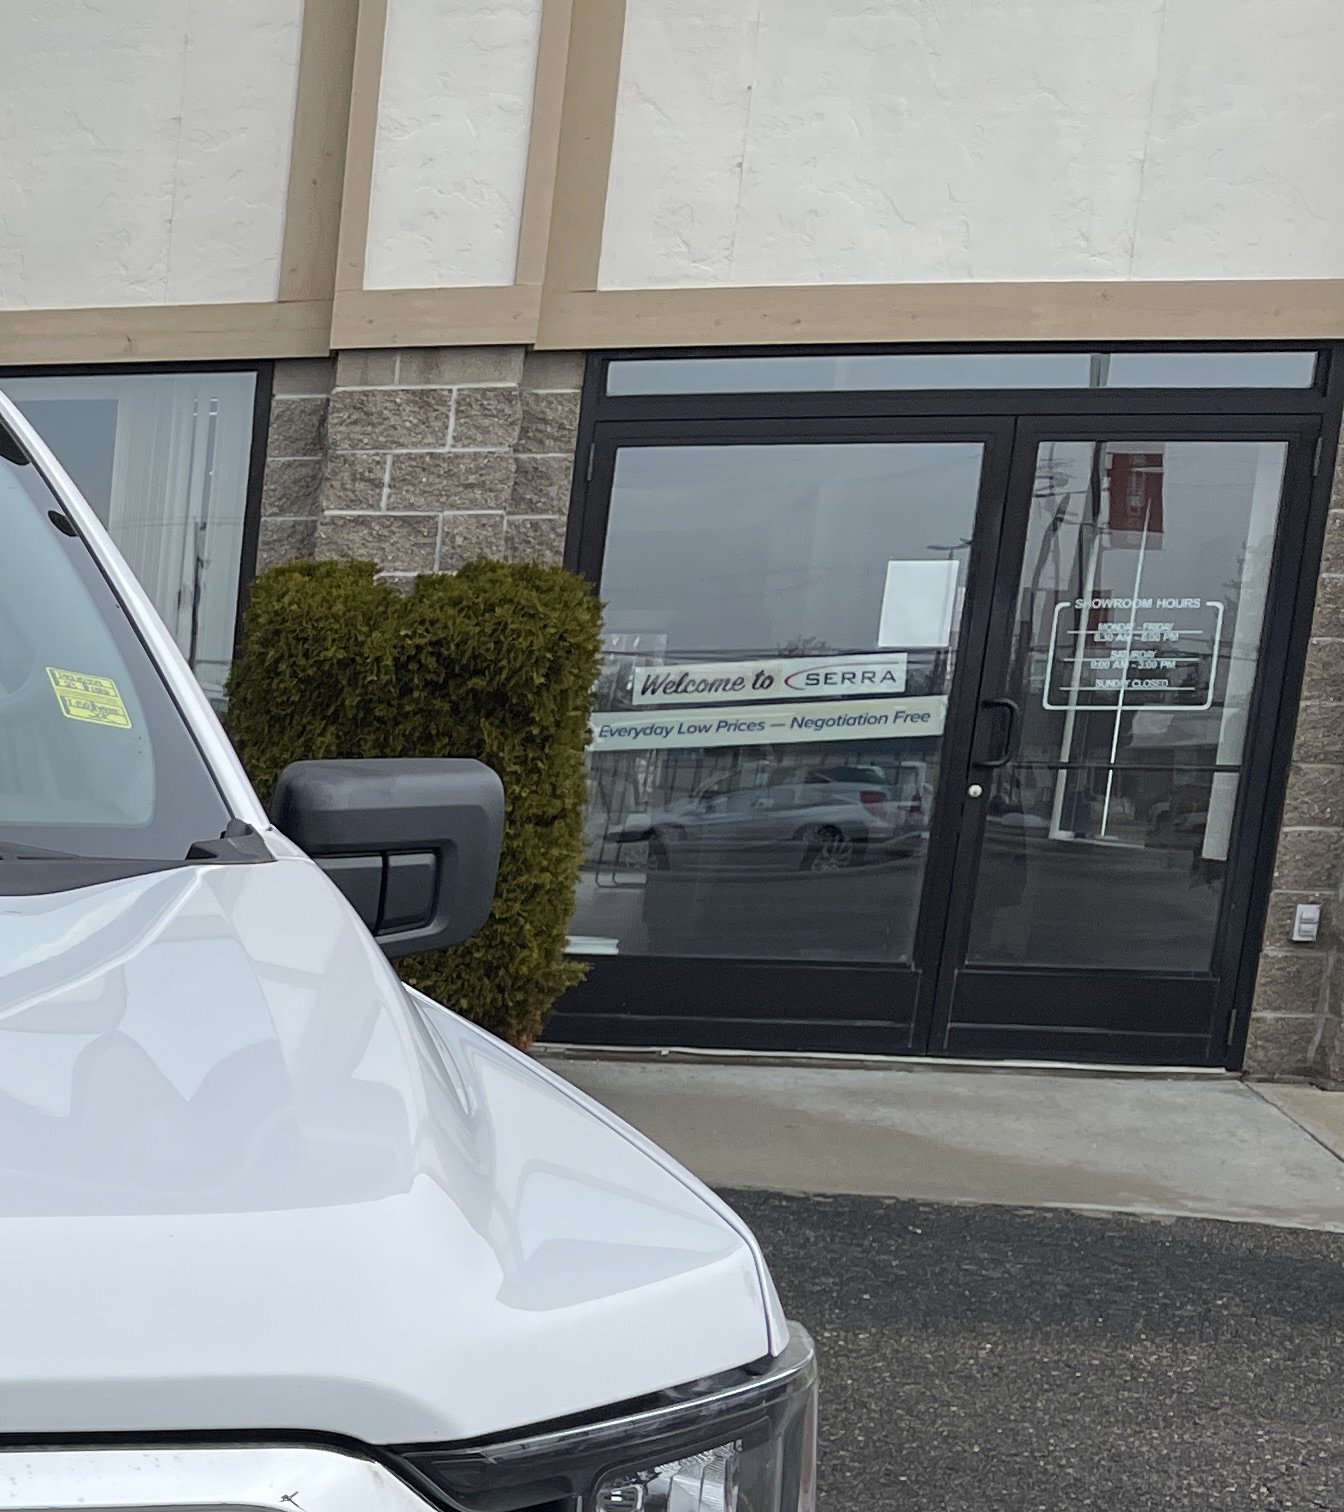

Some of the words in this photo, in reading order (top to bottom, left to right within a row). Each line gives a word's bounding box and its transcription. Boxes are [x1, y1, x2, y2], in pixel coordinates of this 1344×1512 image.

[1074, 598, 1152, 609] SHOWROOM
[1156, 598, 1201, 609] HOURS
[640, 671, 746, 695] Welcome
[752, 670, 775, 690] to
[805, 670, 897, 686] SERRA
[598, 723, 675, 740] Everyday
[677, 722, 713, 735] Low
[715, 719, 766, 733] Prices
[790, 713, 889, 731] Negotiation
[893, 710, 931, 725] Free
